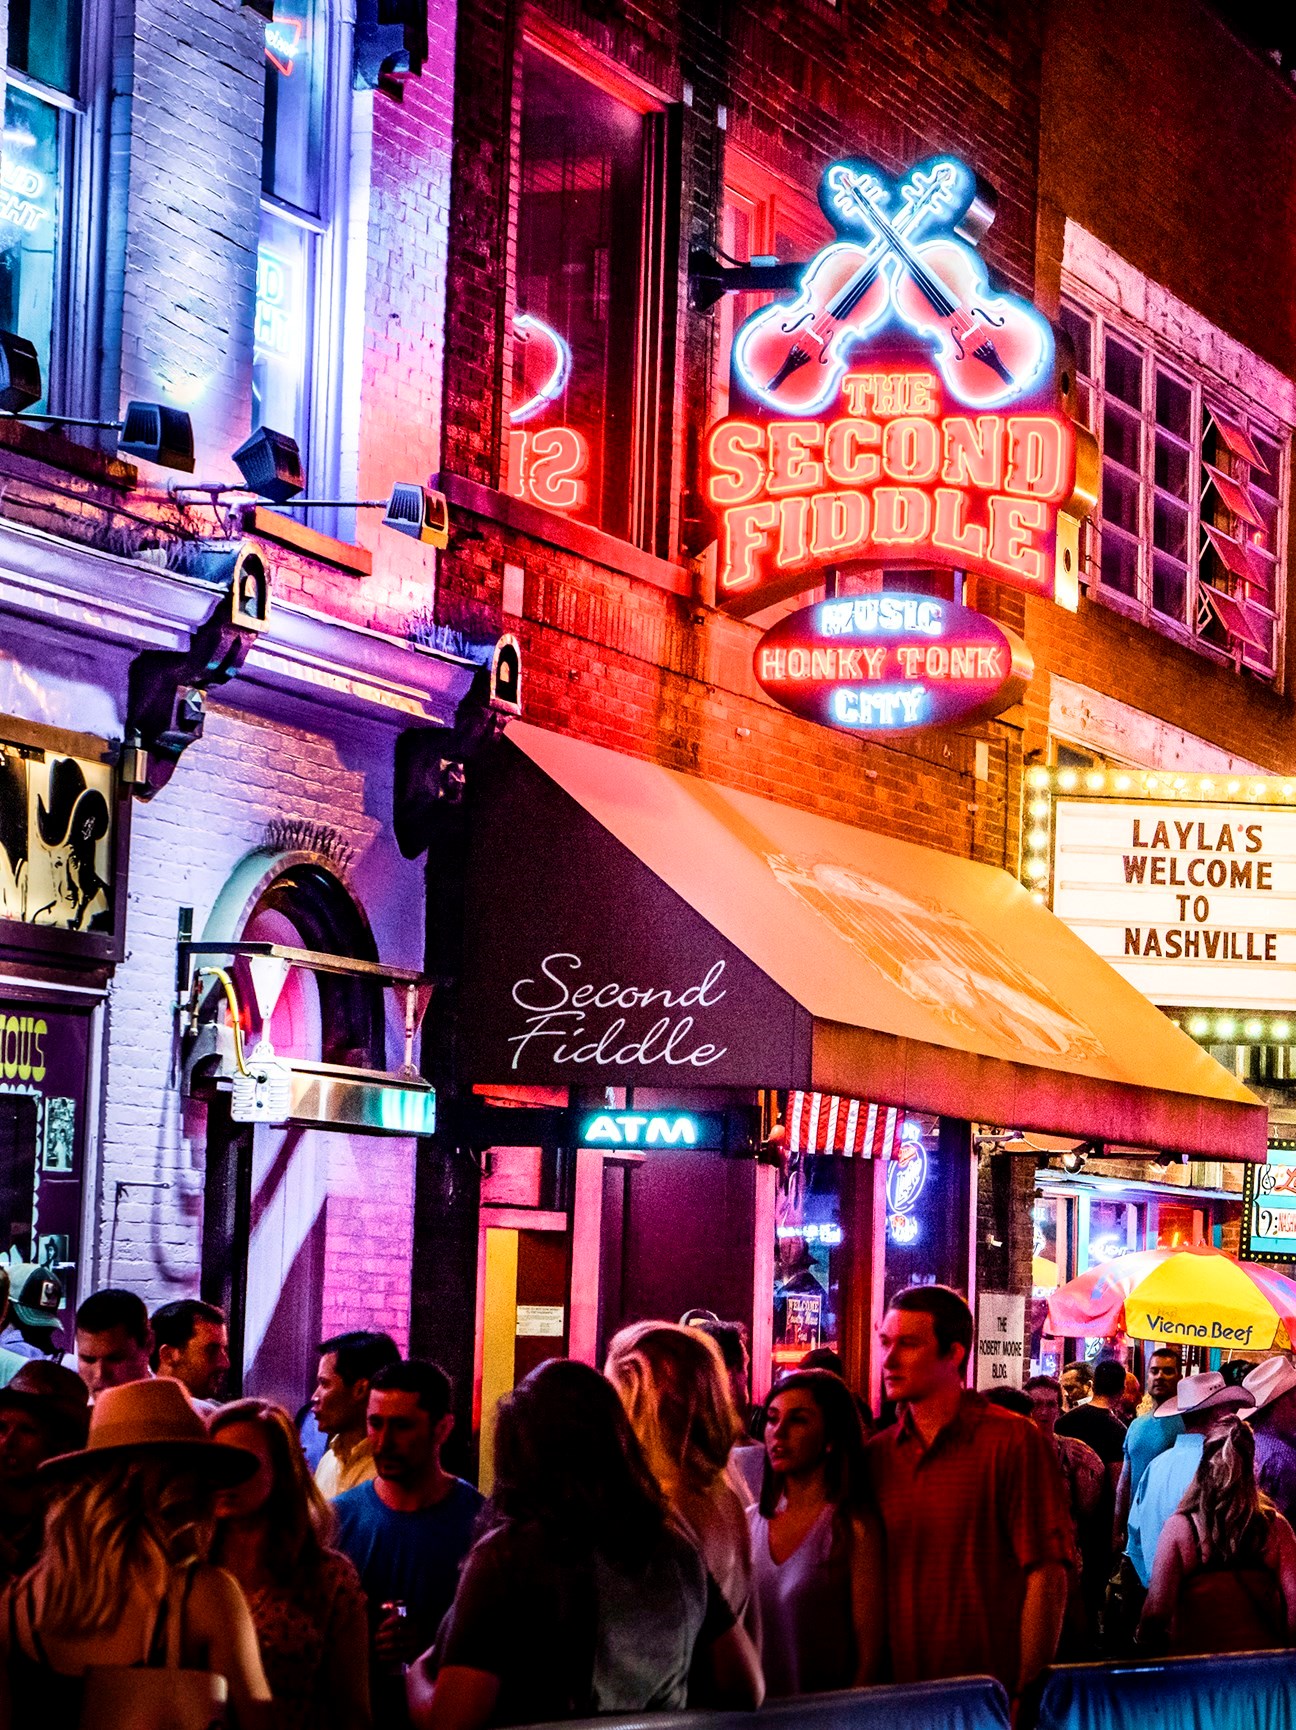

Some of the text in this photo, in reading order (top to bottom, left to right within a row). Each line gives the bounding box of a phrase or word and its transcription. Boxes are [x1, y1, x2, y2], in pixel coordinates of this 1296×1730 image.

[842, 373, 938, 415] THE
[709, 415, 1068, 503] SECOND
[723, 486, 1049, 587] FIDDLE
[821, 598, 942, 637] MUSIC
[761, 646, 1003, 681] HONKY TONK
[834, 686, 926, 725] CITY
[1132, 819, 1263, 853] LAYLA'S
[1122, 855, 1273, 890] WELCOME
[1175, 894, 1210, 922] TO
[1124, 927, 1277, 961] NASHVILLE
[511, 952, 727, 1012] Second
[507, 1010, 728, 1070] Fiddle
[584, 1115, 697, 1144] ATM
[996, 1315, 1008, 1333] THE
[1146, 1313, 1254, 1346] Vienna Beef
[979, 1339, 1022, 1358] ROBERT MOORE
